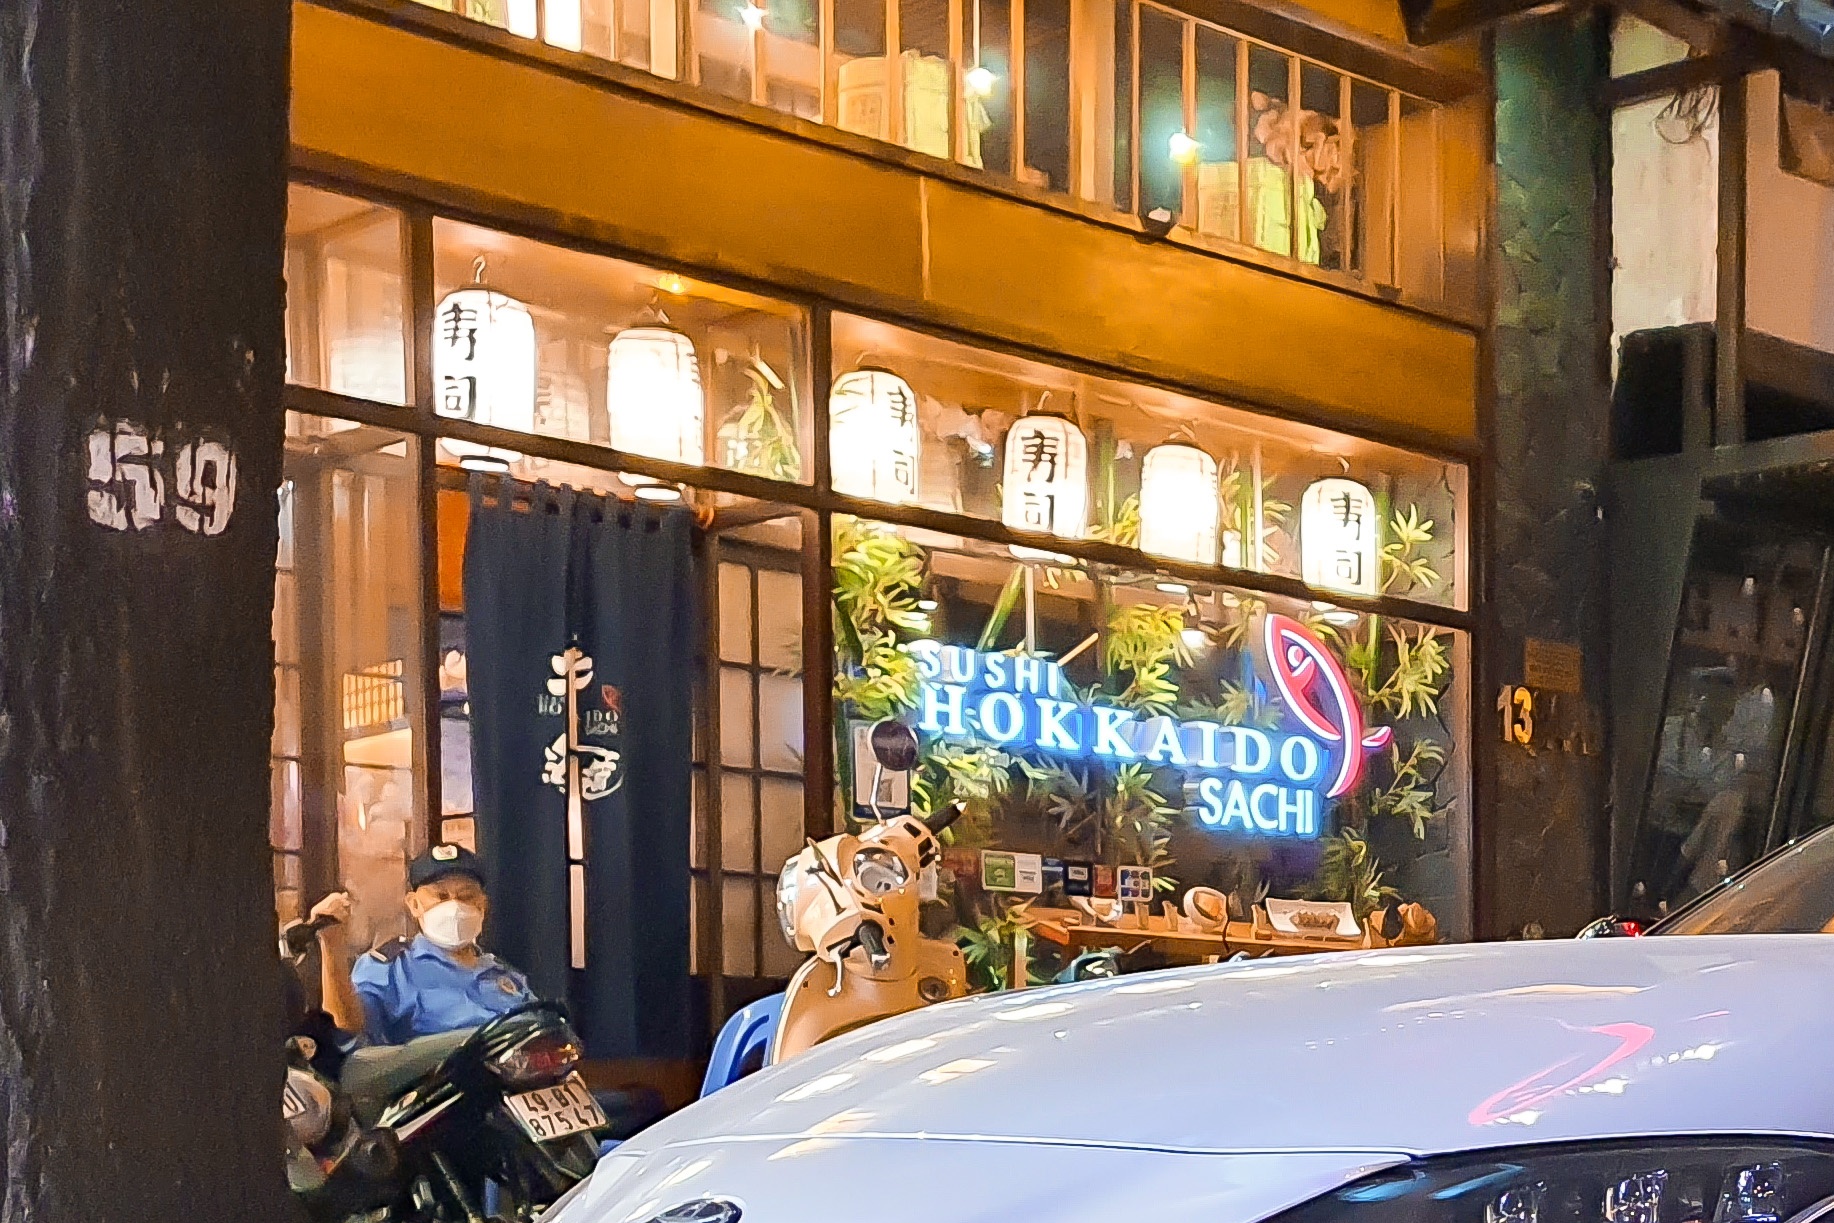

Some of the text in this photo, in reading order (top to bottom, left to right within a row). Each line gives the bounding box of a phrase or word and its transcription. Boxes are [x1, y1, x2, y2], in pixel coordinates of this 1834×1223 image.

[87, 429, 237, 535] 59
[919, 645, 1060, 697] SUSHI
[917, 681, 1319, 782] HOKKAIDO
[1497, 685, 1533, 744] 13
[1198, 777, 1314, 834] SACHI
